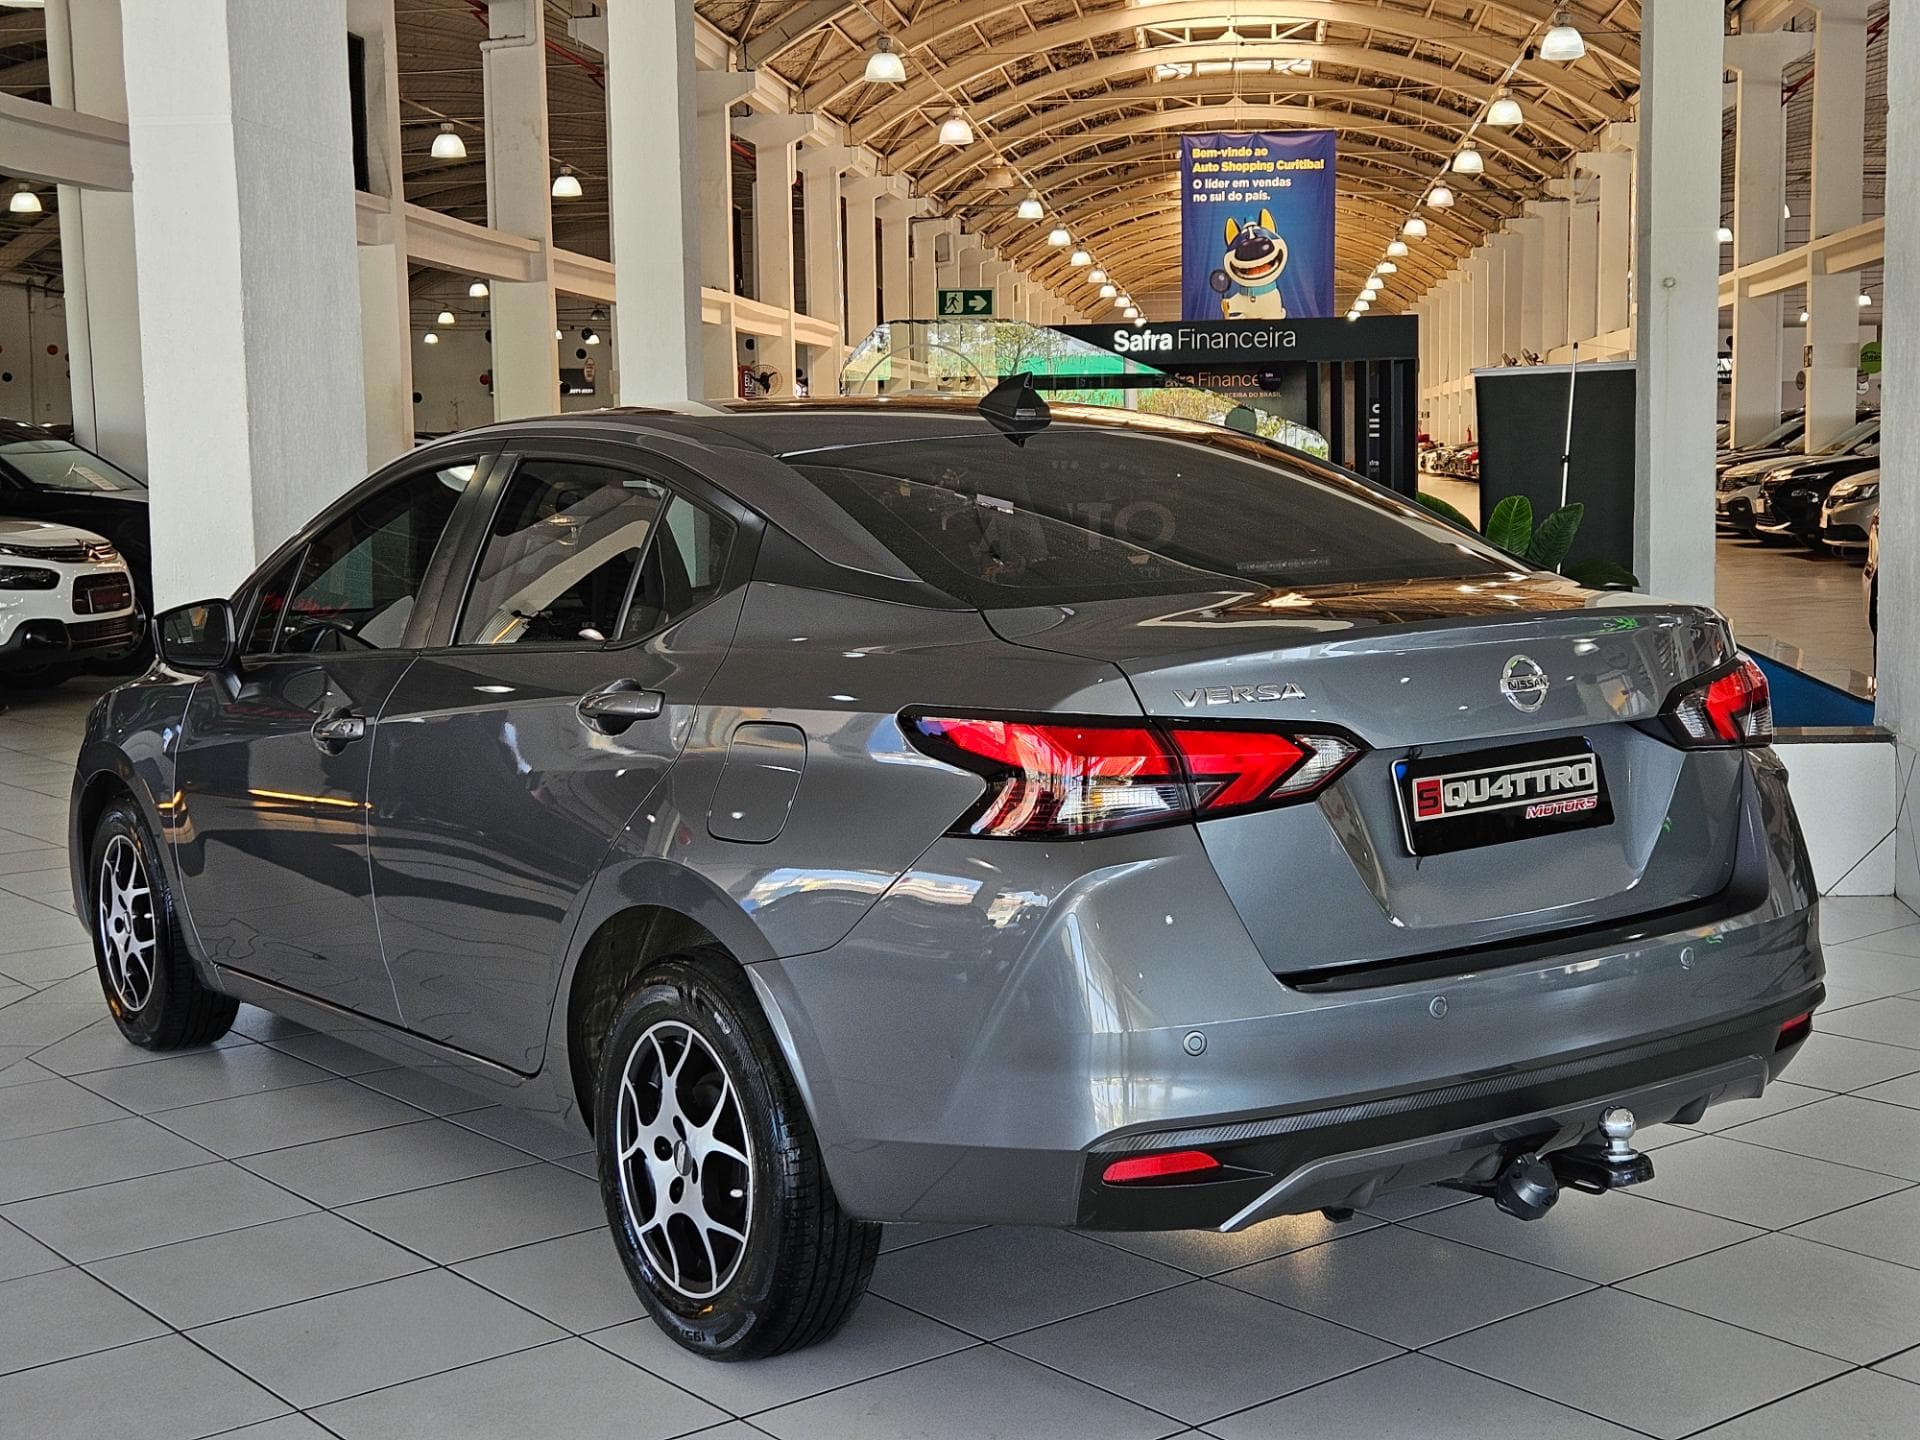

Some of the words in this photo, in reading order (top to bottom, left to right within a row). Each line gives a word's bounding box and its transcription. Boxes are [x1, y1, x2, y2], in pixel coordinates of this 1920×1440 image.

[1192, 147, 1253, 158] Bem-vindo
[1254, 147, 1269, 157] ao
[1192, 162, 1220, 173] Auto
[1221, 160, 1275, 173] Shopping
[1192, 179, 1203, 189] O
[1204, 178, 1230, 189] líder
[1232, 179, 1250, 189] em
[1252, 176, 1292, 188] vendas
[1192, 192, 1208, 202] no
[1209, 191, 1226, 201] sul
[1227, 191, 1243, 201] do
[1245, 190, 1271, 202] país.
[1113, 329, 1173, 352] Safra
[1177, 326, 1297, 350] Financeira
[1198, 371, 1260, 387] Finance
[1507, 677, 1548, 691] NISSAN
[1172, 682, 1307, 708] VERSA
[1525, 795, 1599, 819] MOTORS
